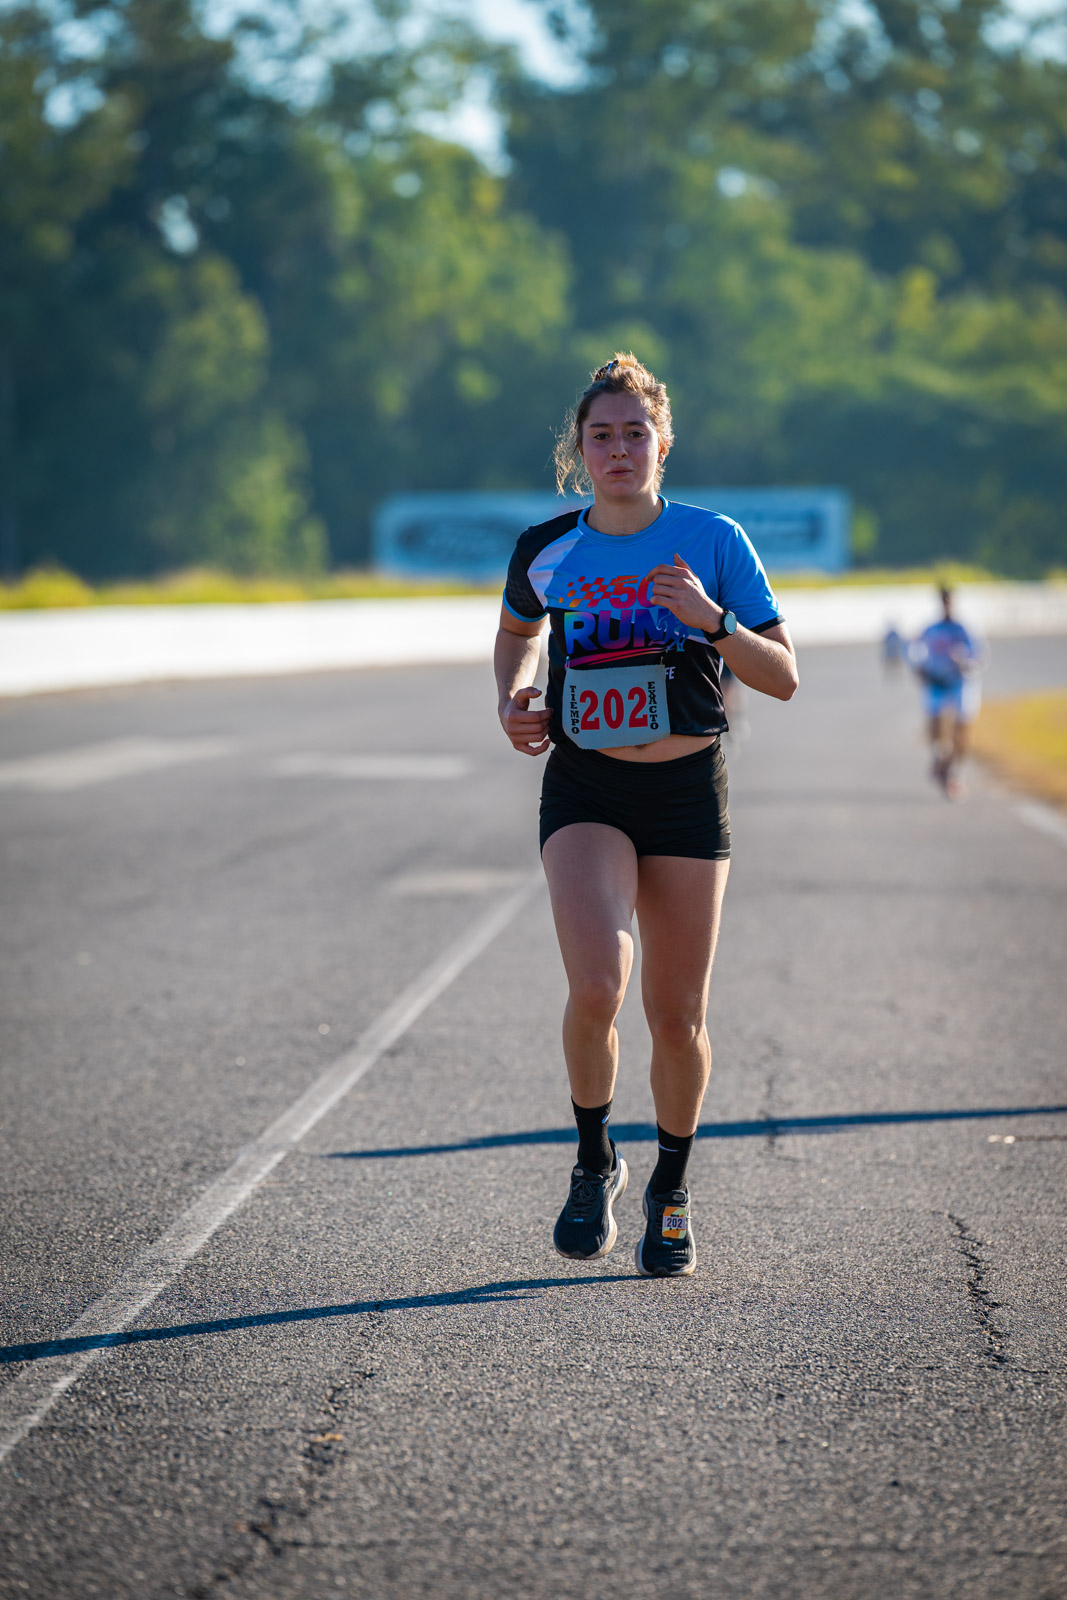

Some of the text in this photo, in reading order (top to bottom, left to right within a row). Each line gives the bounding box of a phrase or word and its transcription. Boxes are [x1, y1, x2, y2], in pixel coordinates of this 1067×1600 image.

[564, 609, 671, 654] RUN
[569, 685, 580, 735] TIEMPO
[579, 686, 649, 731] 202
[647, 681, 659, 730] EXACTO
[666, 1217, 683, 1228] 202
